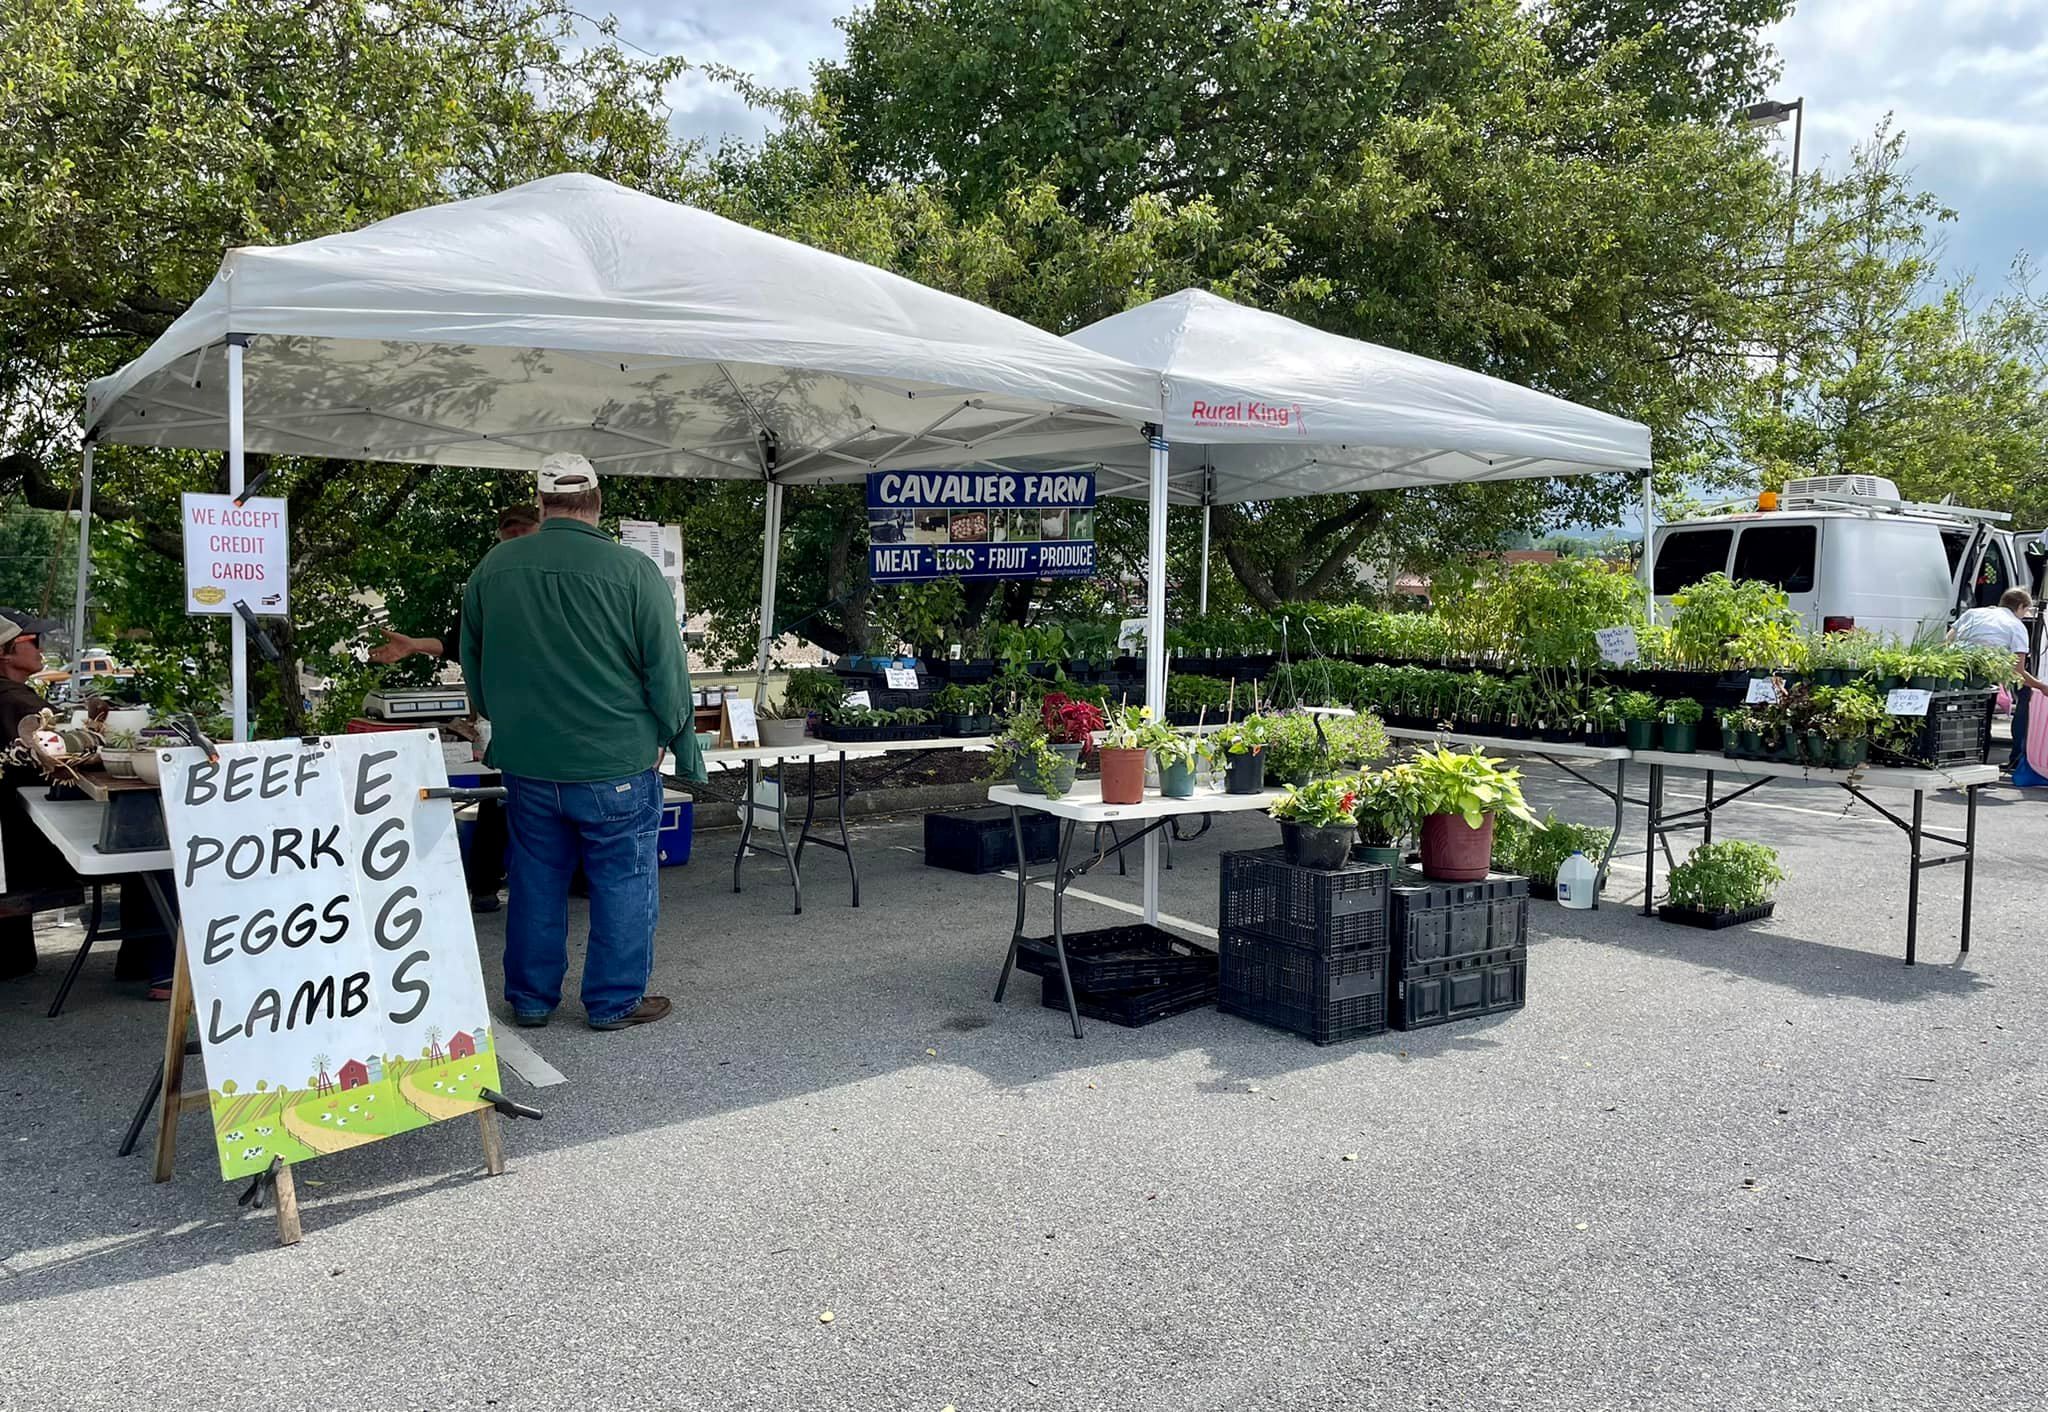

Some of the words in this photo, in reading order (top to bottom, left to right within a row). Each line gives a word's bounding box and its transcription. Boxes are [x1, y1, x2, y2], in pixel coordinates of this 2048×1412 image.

[1192, 401, 1240, 420] Rural
[1248, 402, 1289, 426] King
[880, 474, 1016, 504] CAVALIER
[1024, 475, 1088, 503] FARM
[192, 508, 216, 525] WE
[221, 510, 279, 528] ACCEPT
[210, 535, 265, 554] CREDIT
[875, 549, 921, 572] MEAT
[988, 547, 1028, 569] FRUIT
[1039, 545, 1093, 567] PRODUCE
[212, 562, 265, 581] CARDS
[184, 751, 325, 806] BEEF
[184, 824, 345, 888] PORK
[203, 894, 351, 965] EGGS
[208, 971, 371, 1045] LAMB
